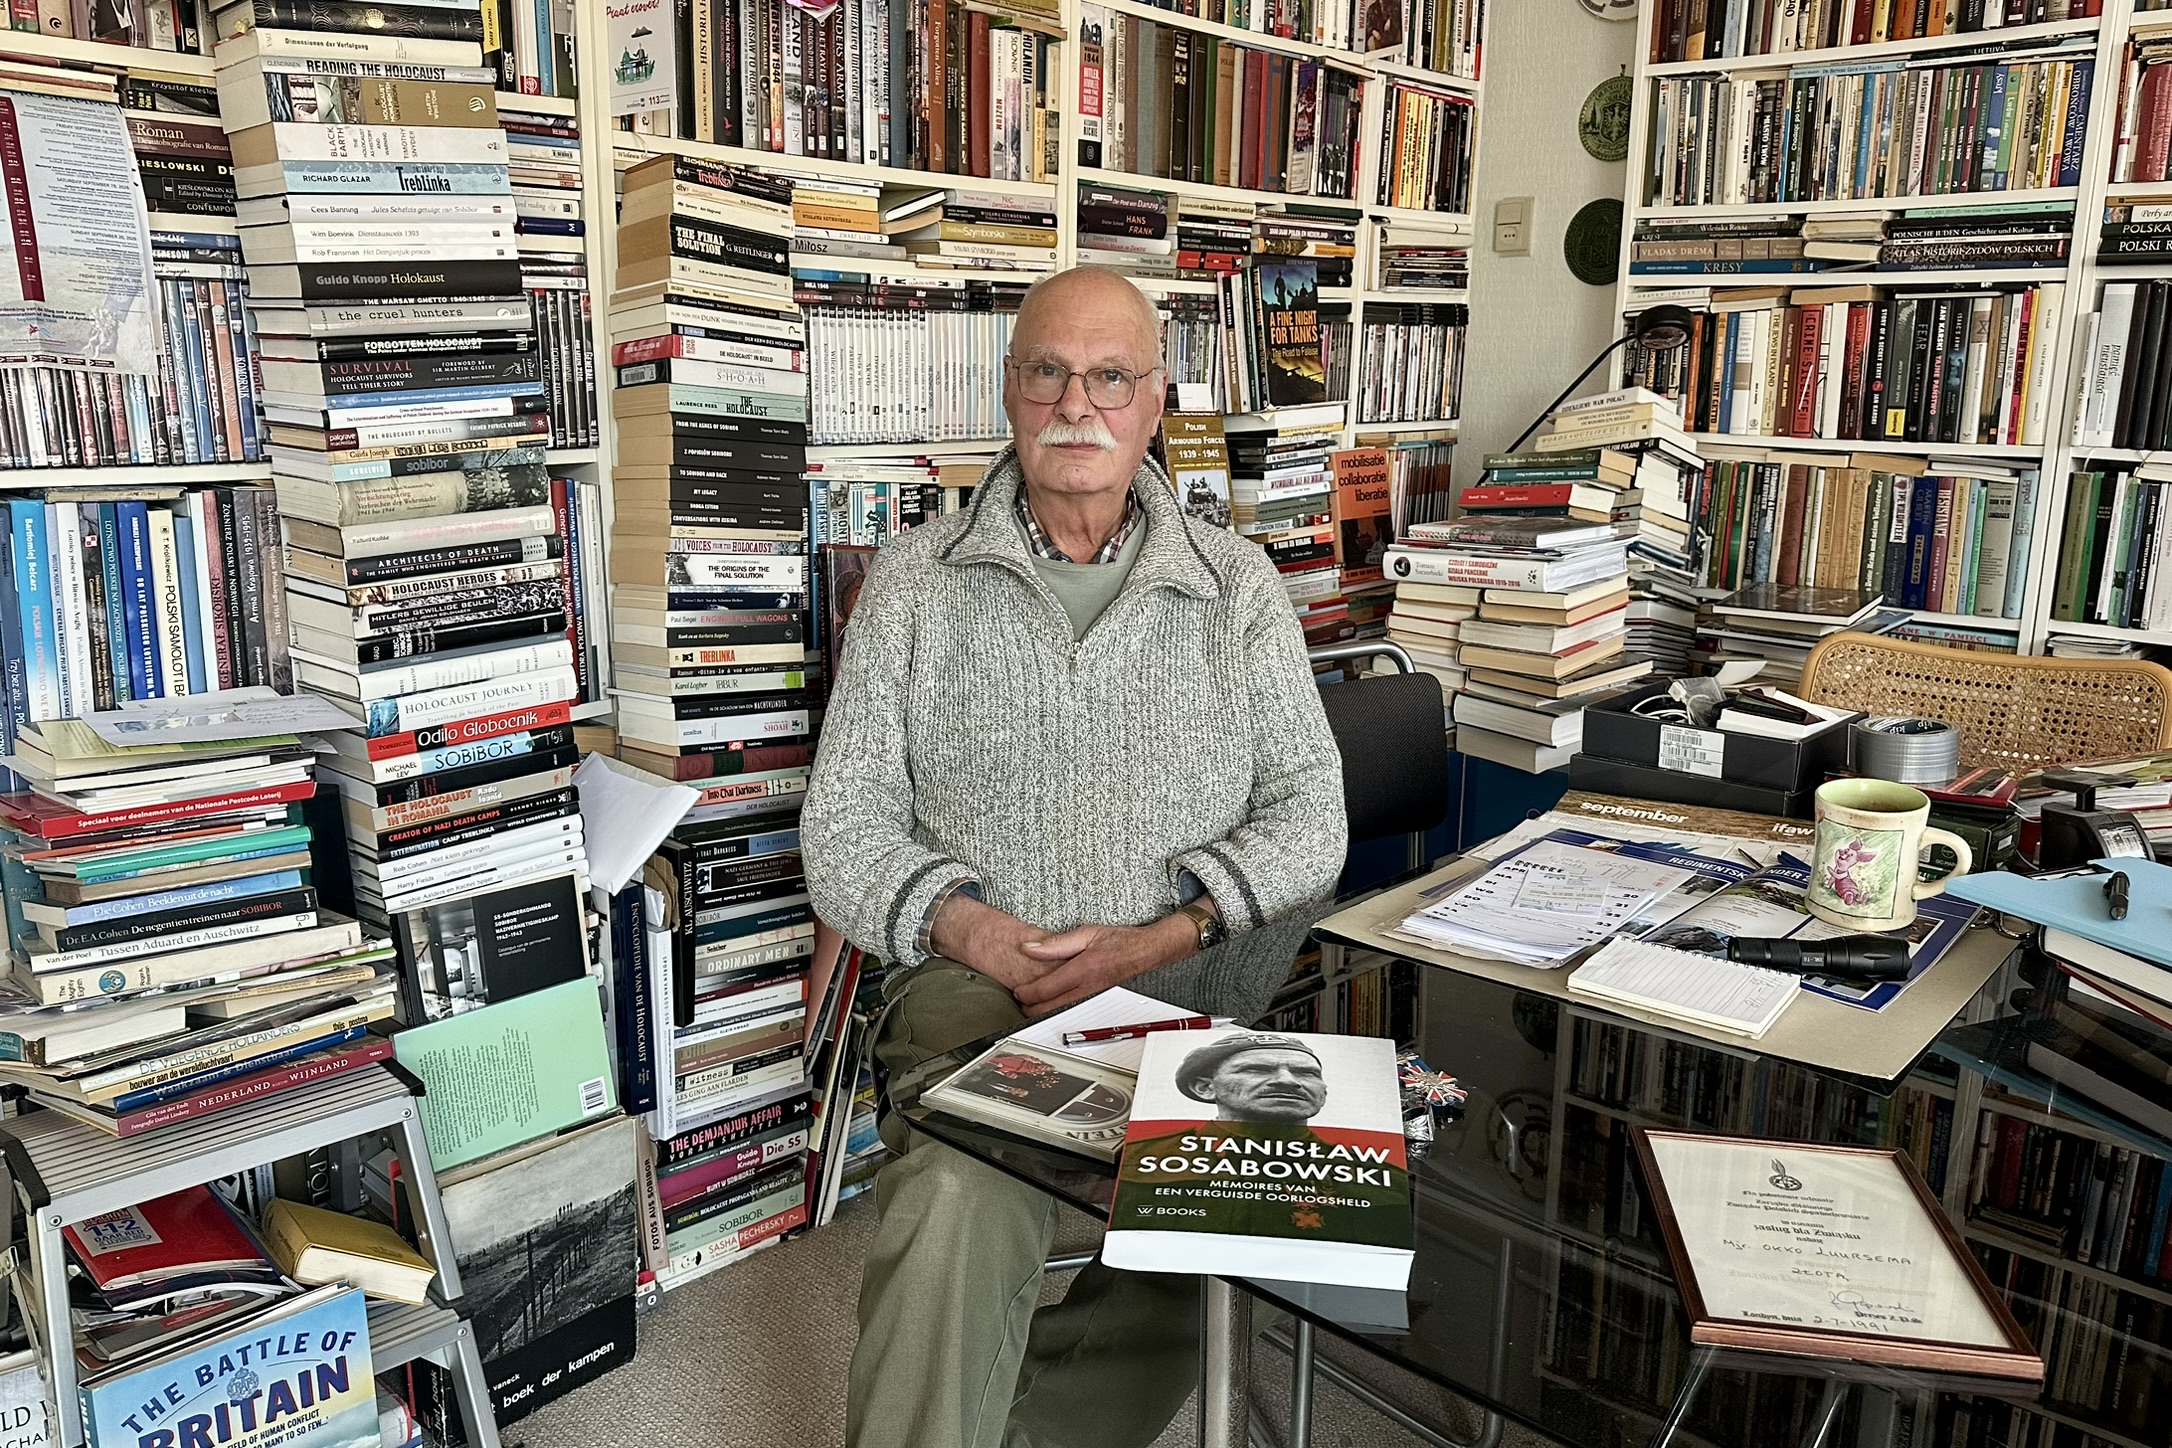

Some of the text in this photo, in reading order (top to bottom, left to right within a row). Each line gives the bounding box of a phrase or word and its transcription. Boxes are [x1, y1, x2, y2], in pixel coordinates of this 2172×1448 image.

[835, 4, 845, 102] ANDERS' ARMY
[1023, 34, 1032, 84] HOLANDIA
[306, 59, 446, 80] READING THE HOLOCAUST
[135, 123, 184, 139] Roman
[339, 127, 348, 158] EARTH
[2070, 114, 2085, 171] CMENTARZ
[302, 174, 371, 183] RICHARD GLAZAR
[396, 166, 451, 192] Treblinka
[311, 206, 359, 215] Cees Banning
[676, 226, 725, 246] THE FINAL
[1893, 229, 1933, 240] POLNISCHE
[1934, 229, 1960, 238] JUDEN
[1961, 227, 1997, 237] Geschichte
[2012, 226, 2034, 234] Kultur
[676, 238, 721, 256] SOLUTION
[733, 244, 774, 260] REITLINGER
[794, 240, 828, 253] Miłosz
[1703, 262, 1744, 273] KRESY
[316, 271, 445, 286] Guido Knopp Holokaust
[338, 308, 463, 321] the cruel hunters
[1270, 310, 1317, 327] A FINE NIGHT
[1271, 326, 1318, 344] FOR TANKS
[330, 362, 412, 375] SURVIVAL
[1930, 305, 1947, 415] JAN KARSKI TAJNE PAŃSTWO
[330, 372, 413, 383] HOLOCAUST SURVIVORS
[342, 380, 404, 390] TELL THEIR STORY
[676, 400, 702, 408] LAURENCE
[726, 404, 768, 416] HOLOCAUST
[740, 396, 752, 406] THE
[1710, 382, 1721, 424] HET GETTO
[1185, 422, 1207, 431] POLISH
[1168, 436, 1225, 445] ARMOURED FORCES
[1178, 449, 1197, 459] 1939
[1203, 449, 1220, 458] 1945
[1341, 453, 1385, 469] mobilisatie
[406, 458, 448, 472] sobibor
[1339, 471, 1386, 486] collaboratie
[1355, 488, 1388, 501] liberatie
[568, 497, 576, 531] Warszawie
[1934, 488, 1952, 538] RESISTANCE
[378, 546, 500, 568] ARCHITECTS OF DEATH
[571, 542, 580, 579] POLSKIEGO
[1911, 535, 1924, 584] THE BOYS
[247, 558, 260, 623] Armia Krajowa
[211, 576, 229, 683] GENERAŁ SIKORSKI
[682, 616, 697, 624] Siegel
[576, 615, 586, 649] POLOWA
[700, 650, 735, 662] TREBLINKA
[578, 651, 587, 686] KATEDRA
[404, 682, 533, 714] HOLOCAUST JOURNEY
[418, 711, 538, 746] Odilo Globocnik
[434, 740, 514, 770] SOBIBOR
[78, 791, 282, 828] Speciaal voor deelnemers van de Nationale Postcode Loterij
[1580, 801, 1689, 824] september
[388, 810, 500, 842] CREATOR OF NAZI DEATH CAMPS
[1771, 823, 1815, 836] ifaw
[241, 901, 283, 916] SOBIBOR
[684, 861, 694, 936] KL AUSCHWITZ
[99, 923, 260, 957] Tussen Aduard en Auschwitz
[707, 946, 789, 973] ORDINARY MEN
[630, 902, 646, 1062] ENCYCLOPEDIE VAN DE HOLOCAUST
[198, 1059, 348, 1108] NEDERLAND WIJNLAND
[669, 1105, 782, 1153] THE DEMJANJUK AFFAIR
[767, 1135, 801, 1156] Die SS
[1179, 1135, 1391, 1164] STANISŁAW
[1137, 1156, 1392, 1187] SOSABOWSKI
[1209, 1180, 1316, 1193] MEMOIRES VAN
[645, 1157, 659, 1250] FOTOS AUS SOBIBOR
[1155, 1188, 1371, 1208] EEN VERGUISDE OORLOGSHELD
[719, 1208, 764, 1233] SOBIBOR
[1156, 1207, 1207, 1217] BOOKS
[90, 1220, 140, 1236] 1-1-2
[709, 1216, 785, 1255] SASHA PECHERSKY
[1763, 1243, 1802, 1255] OKKO
[1817, 1247, 1912, 1265] LUURSEMA
[1813, 1315, 1888, 1332] 2-7-1991
[121, 1329, 357, 1434] THE BATTLE OF
[503, 1340, 614, 1409] boek der kampen
[137, 1355, 350, 1448] BRITAIN
